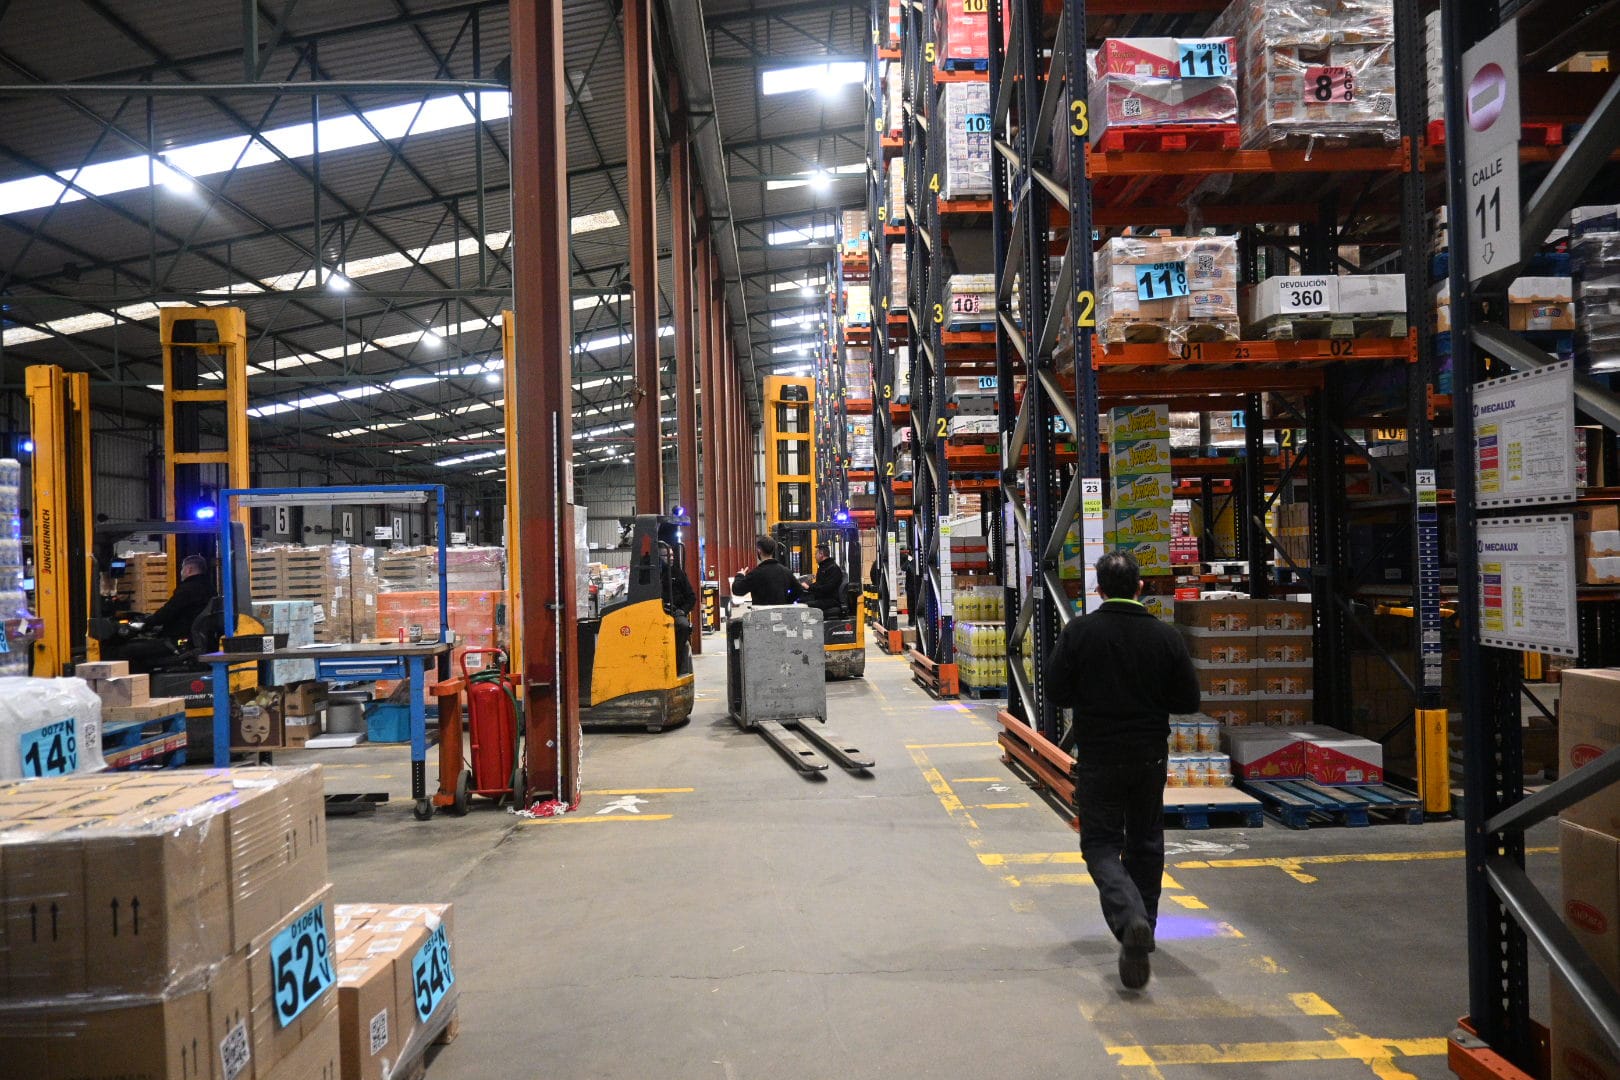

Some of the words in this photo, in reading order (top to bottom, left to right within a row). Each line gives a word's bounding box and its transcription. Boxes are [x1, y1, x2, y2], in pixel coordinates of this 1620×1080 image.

[925, 43, 935, 62] 5
[1181, 50, 1214, 76] 11
[1315, 75, 1332, 101] 8
[966, 117, 986, 131] 10
[1070, 100, 1089, 137] 3
[1472, 158, 1503, 187] CALLE
[929, 173, 939, 193] 4
[1475, 186, 1501, 240] 11
[1139, 270, 1173, 299] 11
[1280, 279, 1327, 289] DEVOLUCIÓN
[881, 296, 888, 309] 4
[954, 298, 974, 312] 10
[1291, 290, 1323, 307] 360
[933, 303, 943, 323] 3
[1077, 290, 1096, 327] 2
[1234, 347, 1250, 358] 23
[883, 384, 892, 398] 3
[979, 378, 993, 387] 10
[1480, 400, 1516, 415] MECALUX
[936, 417, 947, 437] 2
[1281, 429, 1292, 447] 2
[886, 462, 894, 476] 2
[1086, 485, 1098, 493] 23
[1419, 476, 1431, 484] 21
[279, 508, 285, 531] 5
[345, 515, 350, 534] 4
[395, 519, 400, 538] 3
[41, 509, 52, 575] JUNGHEINRICH
[1484, 542, 1519, 552] MECALUX
[41, 723, 65, 738] 0072
[25, 733, 67, 777] 14
[291, 914, 313, 939] 0106
[278, 933, 322, 1017] 52
[415, 945, 445, 1016] 54
